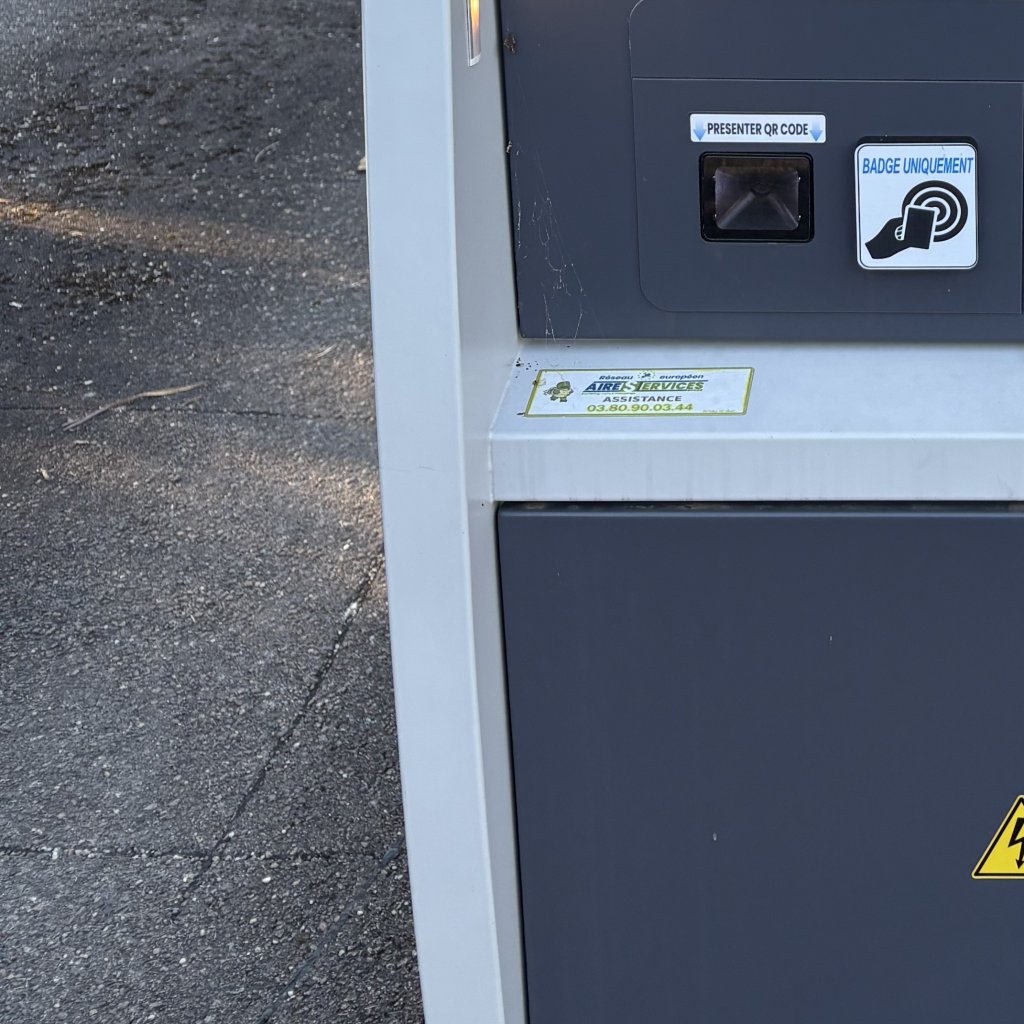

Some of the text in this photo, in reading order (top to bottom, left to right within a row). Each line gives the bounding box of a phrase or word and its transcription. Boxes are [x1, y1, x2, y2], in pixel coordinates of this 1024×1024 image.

[707, 122, 808, 137] PRESENTER QR CODE
[862, 157, 974, 175] BADGE UNIQUEMENT
[603, 395, 682, 403] ASSISTANCE
[587, 403, 694, 412] 03.80.90.03.44
